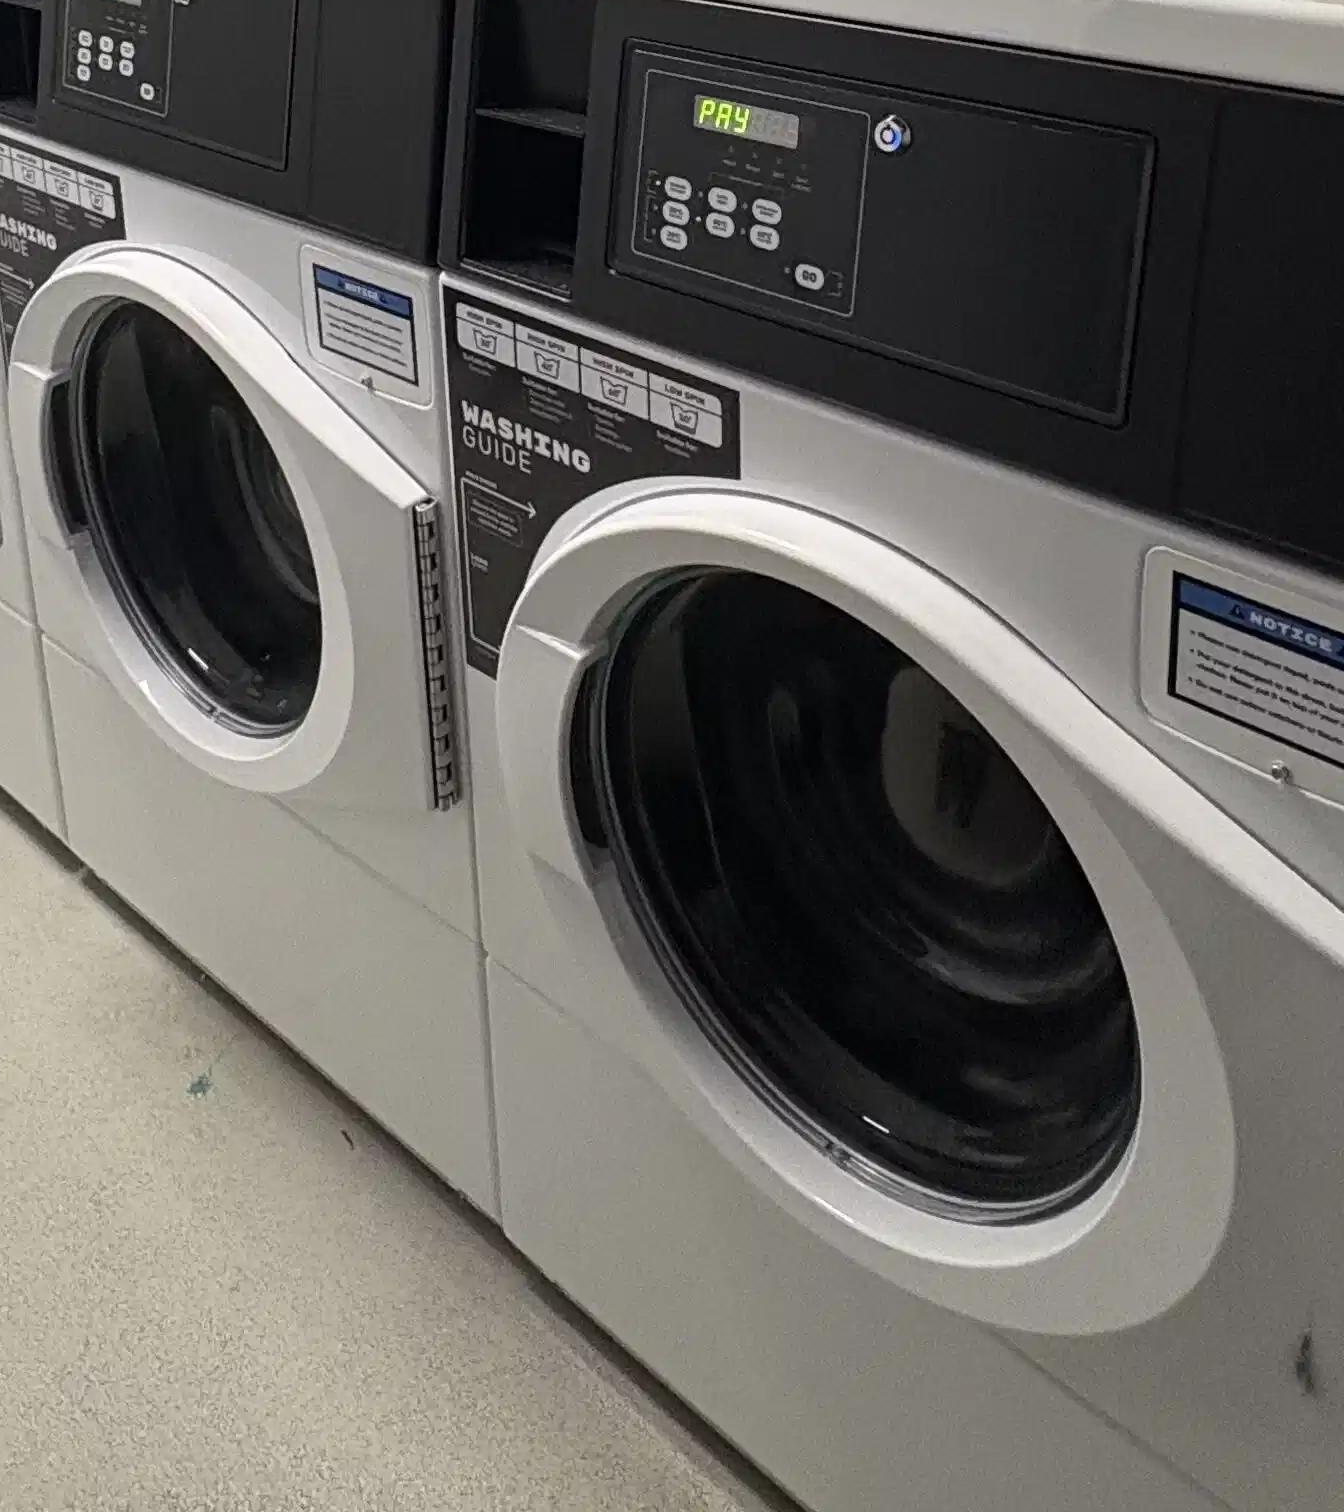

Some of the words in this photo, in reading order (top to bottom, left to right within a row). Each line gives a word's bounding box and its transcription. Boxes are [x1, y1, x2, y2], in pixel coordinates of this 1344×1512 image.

[698, 98, 750, 134] PAY
[460, 399, 592, 474] WASHING
[462, 425, 532, 476] GUIDE
[1249, 611, 1334, 653] NOTICE
